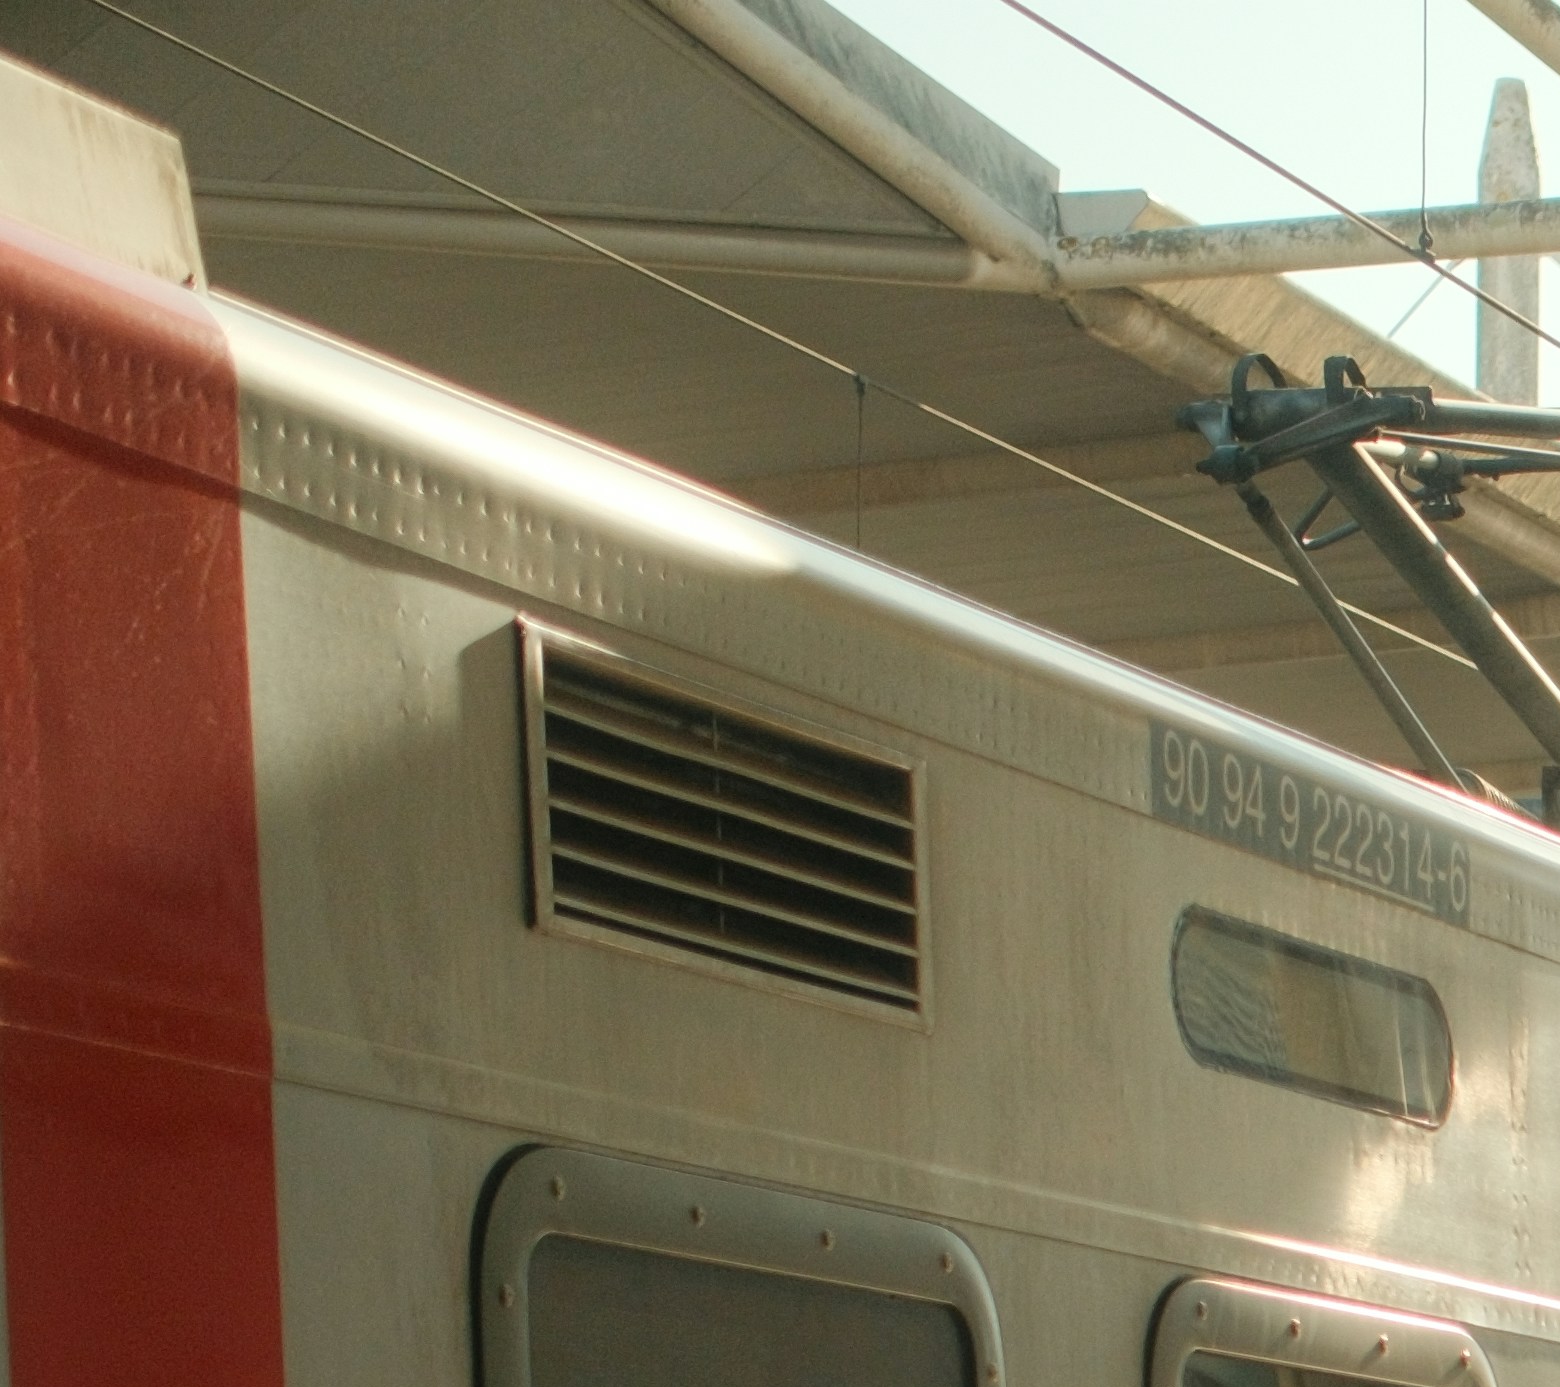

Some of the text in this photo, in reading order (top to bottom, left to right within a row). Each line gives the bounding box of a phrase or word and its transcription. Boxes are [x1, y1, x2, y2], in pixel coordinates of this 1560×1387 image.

[1163, 730, 1468, 913] 90 94 9 222314-6
